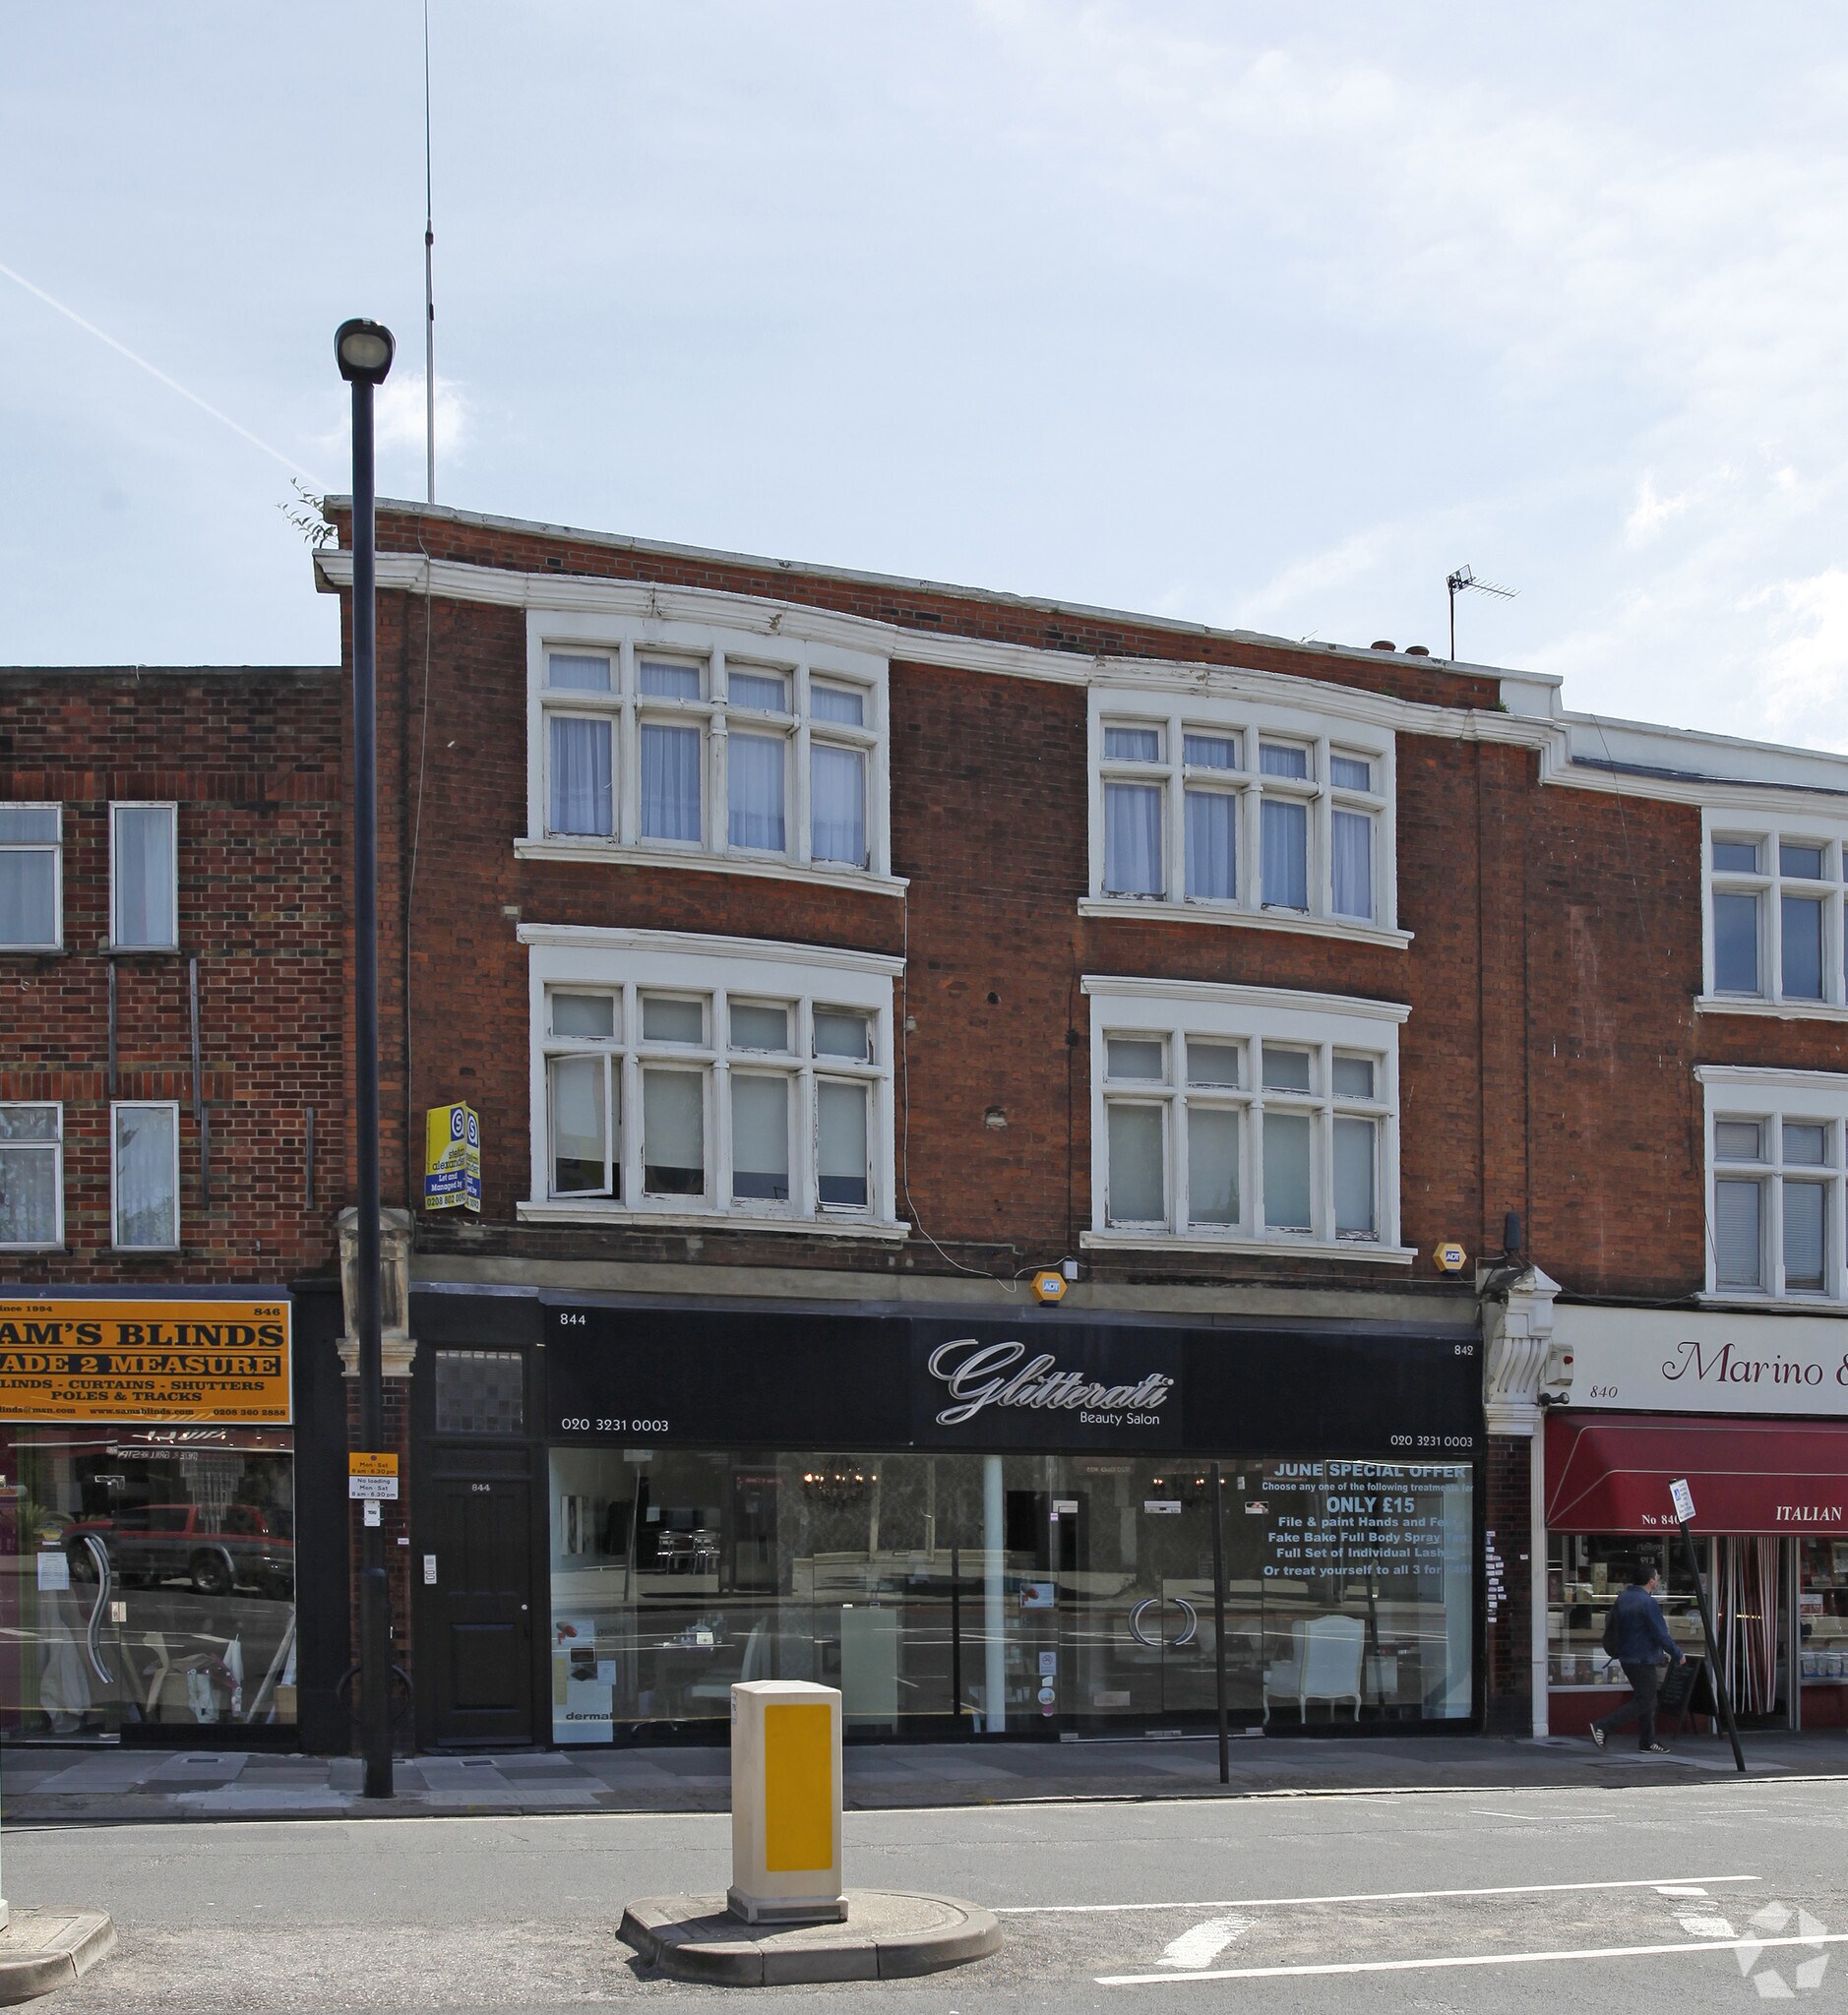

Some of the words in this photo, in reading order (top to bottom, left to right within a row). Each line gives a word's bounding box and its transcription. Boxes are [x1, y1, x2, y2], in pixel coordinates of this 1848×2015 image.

[431, 1181, 456, 1191] Managed
[1043, 1282, 1060, 1291] ADT
[560, 1313, 586, 1325] 844
[116, 1323, 284, 1347] BLINDS
[1454, 1345, 1473, 1356] 842
[80, 1357, 98, 1374] 2
[108, 1356, 277, 1374] MEASURE
[1661, 1341, 1823, 1385] Marino
[68, 1379, 154, 1390] CURTAINS
[170, 1380, 265, 1391] SHUTTERS
[928, 1338, 1175, 1426] Glitterati
[51, 1390, 109, 1400] POLES
[114, 1391, 127, 1401] &
[132, 1391, 202, 1401] TRACKS
[1589, 1385, 1618, 1399] 840
[561, 1418, 590, 1431] 020
[595, 1419, 627, 1431] 3231
[632, 1420, 669, 1432] 0003
[1079, 1412, 1122, 1427] Beauty
[1126, 1413, 1160, 1426] Salon
[1390, 1435, 1413, 1446] 020
[1417, 1435, 1441, 1446] 3231
[1444, 1436, 1473, 1447] 0003
[1274, 1463, 1324, 1477] JUNE
[1329, 1463, 1404, 1477] SPECIAL
[1409, 1464, 1465, 1478] OFFER
[1262, 1482, 1296, 1491] Choose
[1299, 1483, 1316, 1493] any
[1338, 1482, 1347, 1491] of
[1368, 1482, 1408, 1494] following
[1461, 1483, 1474, 1492] for
[1326, 1496, 1377, 1513] ONLY
[1383, 1496, 1415, 1513] £15
[1641, 1514, 1657, 1524] No
[1775, 1505, 1842, 1521] ITALIAN
[1278, 1517, 1303, 1526] File
[1307, 1516, 1317, 1526] &
[1322, 1517, 1354, 1528] paint
[1358, 1517, 1398, 1527] Hands
[1402, 1517, 1425, 1527] and
[1268, 1532, 1300, 1542] Fake
[1304, 1532, 1336, 1542] Bake
[1340, 1532, 1364, 1542] Full
[1369, 1532, 1400, 1544] Body
[1404, 1532, 1441, 1544] Spray
[1276, 1548, 1300, 1557] Full
[1305, 1548, 1326, 1557] Set
[1330, 1548, 1343, 1557] of
[1348, 1548, 1410, 1557] Individual
[1263, 1565, 1279, 1575] Or
[1283, 1565, 1316, 1575] treat
[1320, 1564, 1372, 1577] yourself
[1393, 1564, 1408, 1574] all
[1412, 1565, 1420, 1574] 3
[1424, 1564, 1442, 1574] for
